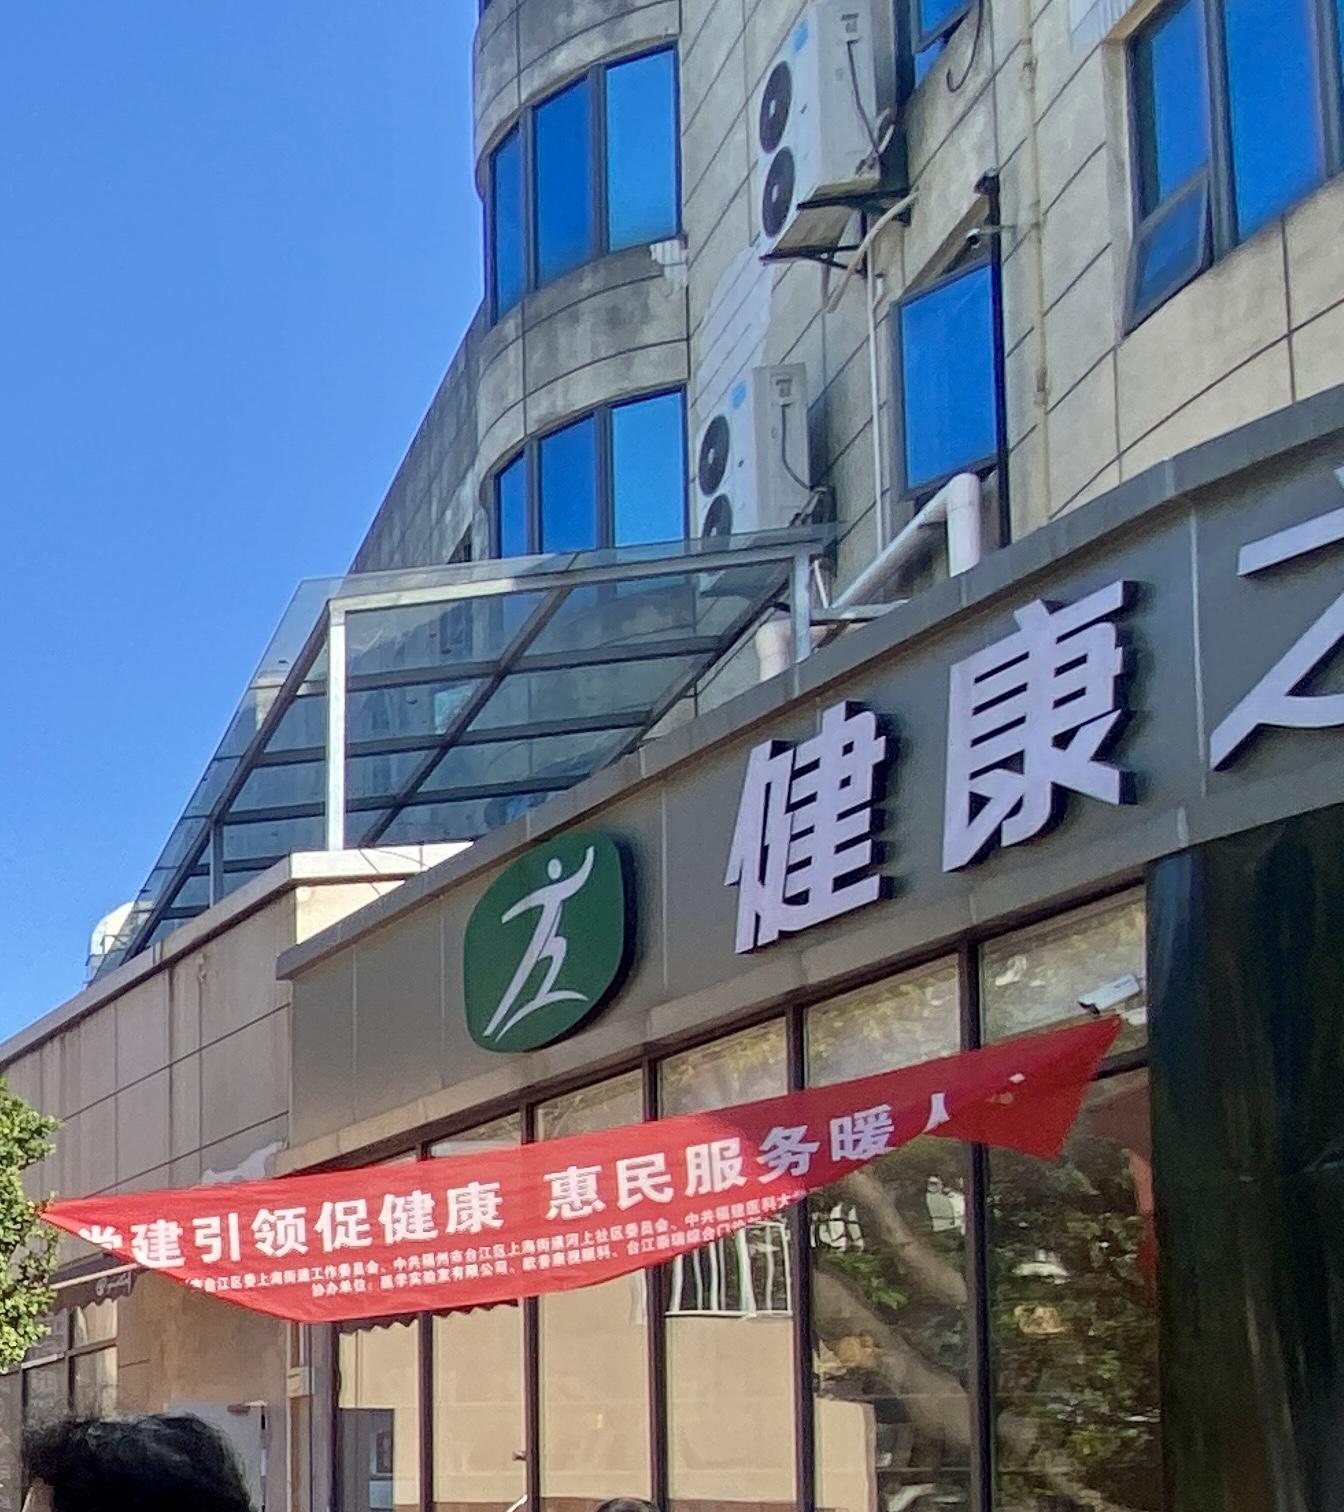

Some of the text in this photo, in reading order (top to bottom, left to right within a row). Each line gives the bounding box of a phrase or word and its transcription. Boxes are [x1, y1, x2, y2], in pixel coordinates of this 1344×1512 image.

[544, 1072, 1026, 1218] 惠民服务暖人
